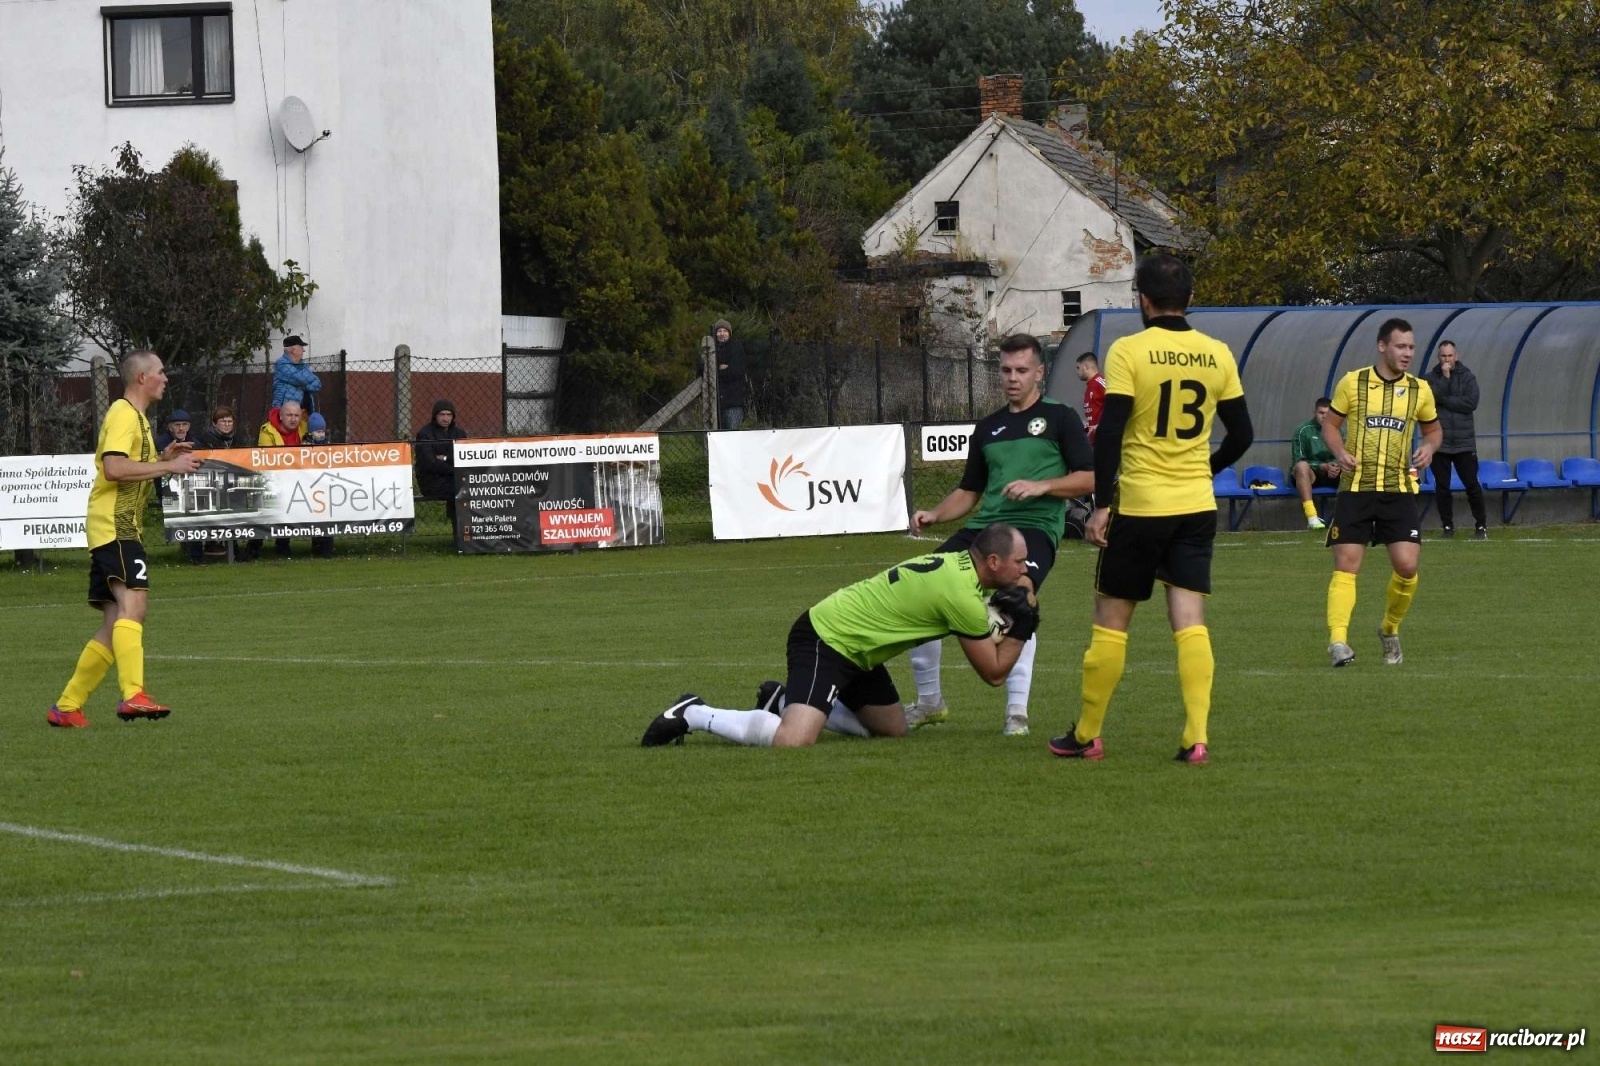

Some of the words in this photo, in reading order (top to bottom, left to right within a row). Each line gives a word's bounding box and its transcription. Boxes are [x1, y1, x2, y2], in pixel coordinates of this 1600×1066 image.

[1149, 350, 1217, 369] LUBOMIA
[1154, 379, 1207, 440] 13
[1367, 417, 1404, 430] SEGET
[926, 435, 970, 452] GOSP
[252, 450, 295, 467] Biuro
[300, 448, 400, 468] Projektowe
[458, 450, 497, 460] USŁUGI
[503, 446, 576, 459] REMONTOWO
[586, 443, 654, 456] BUDOWLANE
[469, 473, 511, 484] BUDOWA
[512, 470, 549, 482] DOMÓW
[0, 483, 42, 493] opomoc
[469, 485, 536, 496] WYKOŃCZENIA
[806, 479, 862, 510] JSW
[13, 493, 58, 504] Lubomia
[286, 477, 402, 517] Aspekt
[538, 498, 585, 510] NOWOŚĆ!
[470, 499, 515, 510] REMONTY
[471, 515, 494, 523] Marek
[549, 513, 604, 525] WYNAJEM
[23, 522, 86, 535] PIEKARNIA
[187, 530, 209, 540] 509
[211, 529, 233, 539] 576
[235, 528, 255, 538] 946
[270, 525, 325, 537] Lubomia,
[327, 524, 341, 535] ul.
[344, 524, 386, 535] Asnyka
[389, 521, 404, 532] 69
[543, 525, 612, 540] SZALUNKÓW
[39, 536, 72, 544] Lubomia
[134, 559, 147, 580] 2
